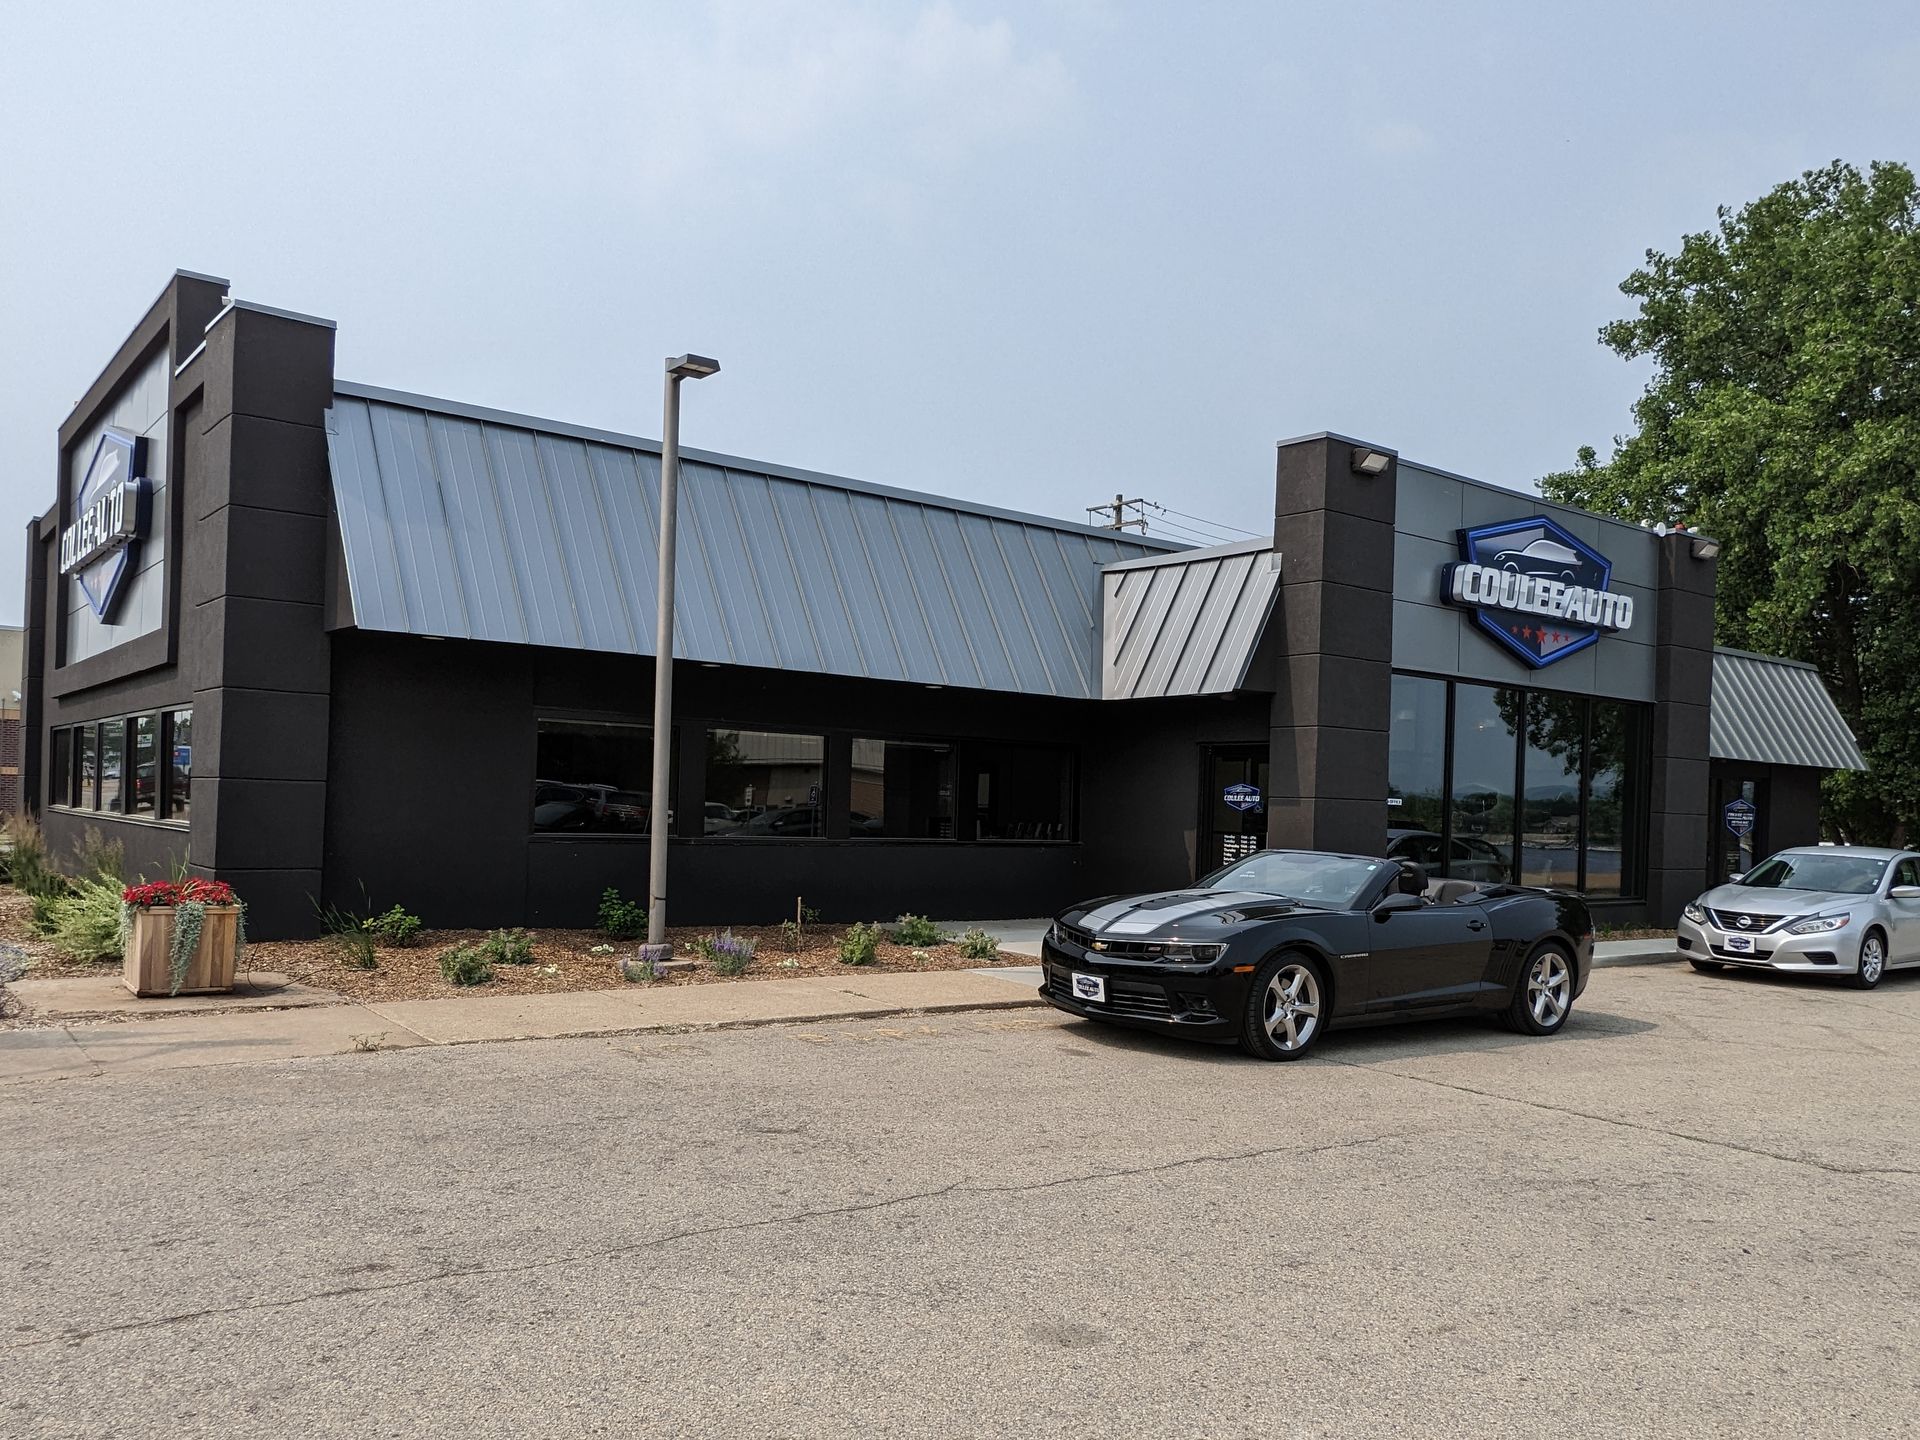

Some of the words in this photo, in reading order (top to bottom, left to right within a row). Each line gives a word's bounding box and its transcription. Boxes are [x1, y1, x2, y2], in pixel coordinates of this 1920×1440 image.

[95, 481, 125, 546] AUTO
[1462, 563, 1565, 618] COULEE
[1564, 586, 1634, 630] AUTO
